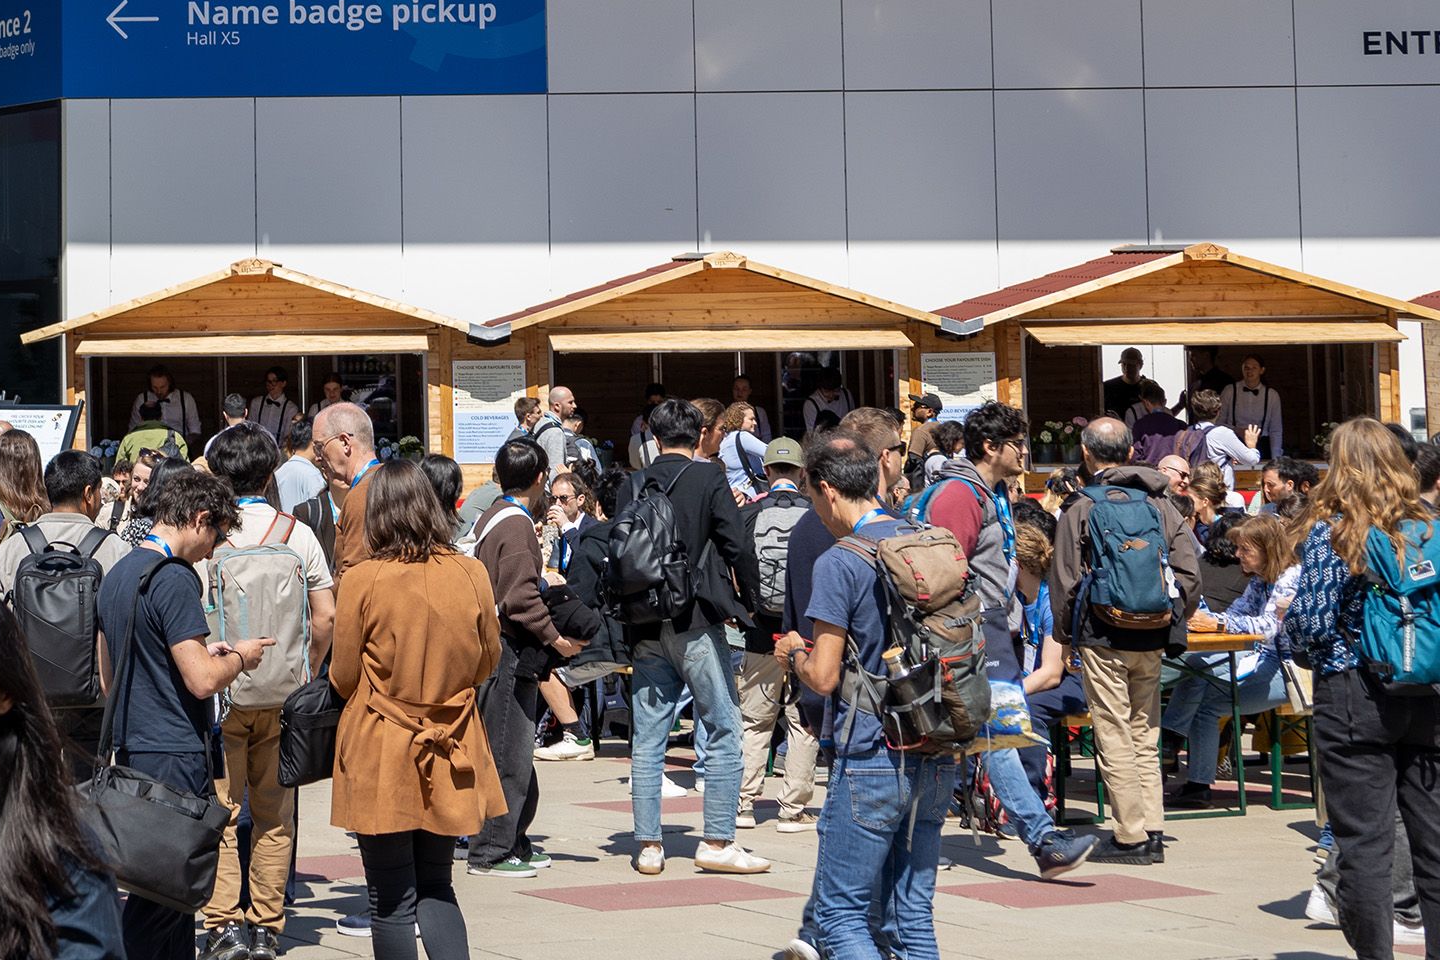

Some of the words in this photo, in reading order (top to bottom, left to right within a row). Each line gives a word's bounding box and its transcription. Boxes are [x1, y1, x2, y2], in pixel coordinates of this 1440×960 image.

[23, 10, 31, 34] 2
[187, 0, 279, 25] Name
[0, 43, 19, 60] badge
[20, 39, 35, 57] only
[187, 31, 217, 45] Hall
[221, 31, 241, 45] X5
[1363, 31, 1440, 55] ENT
